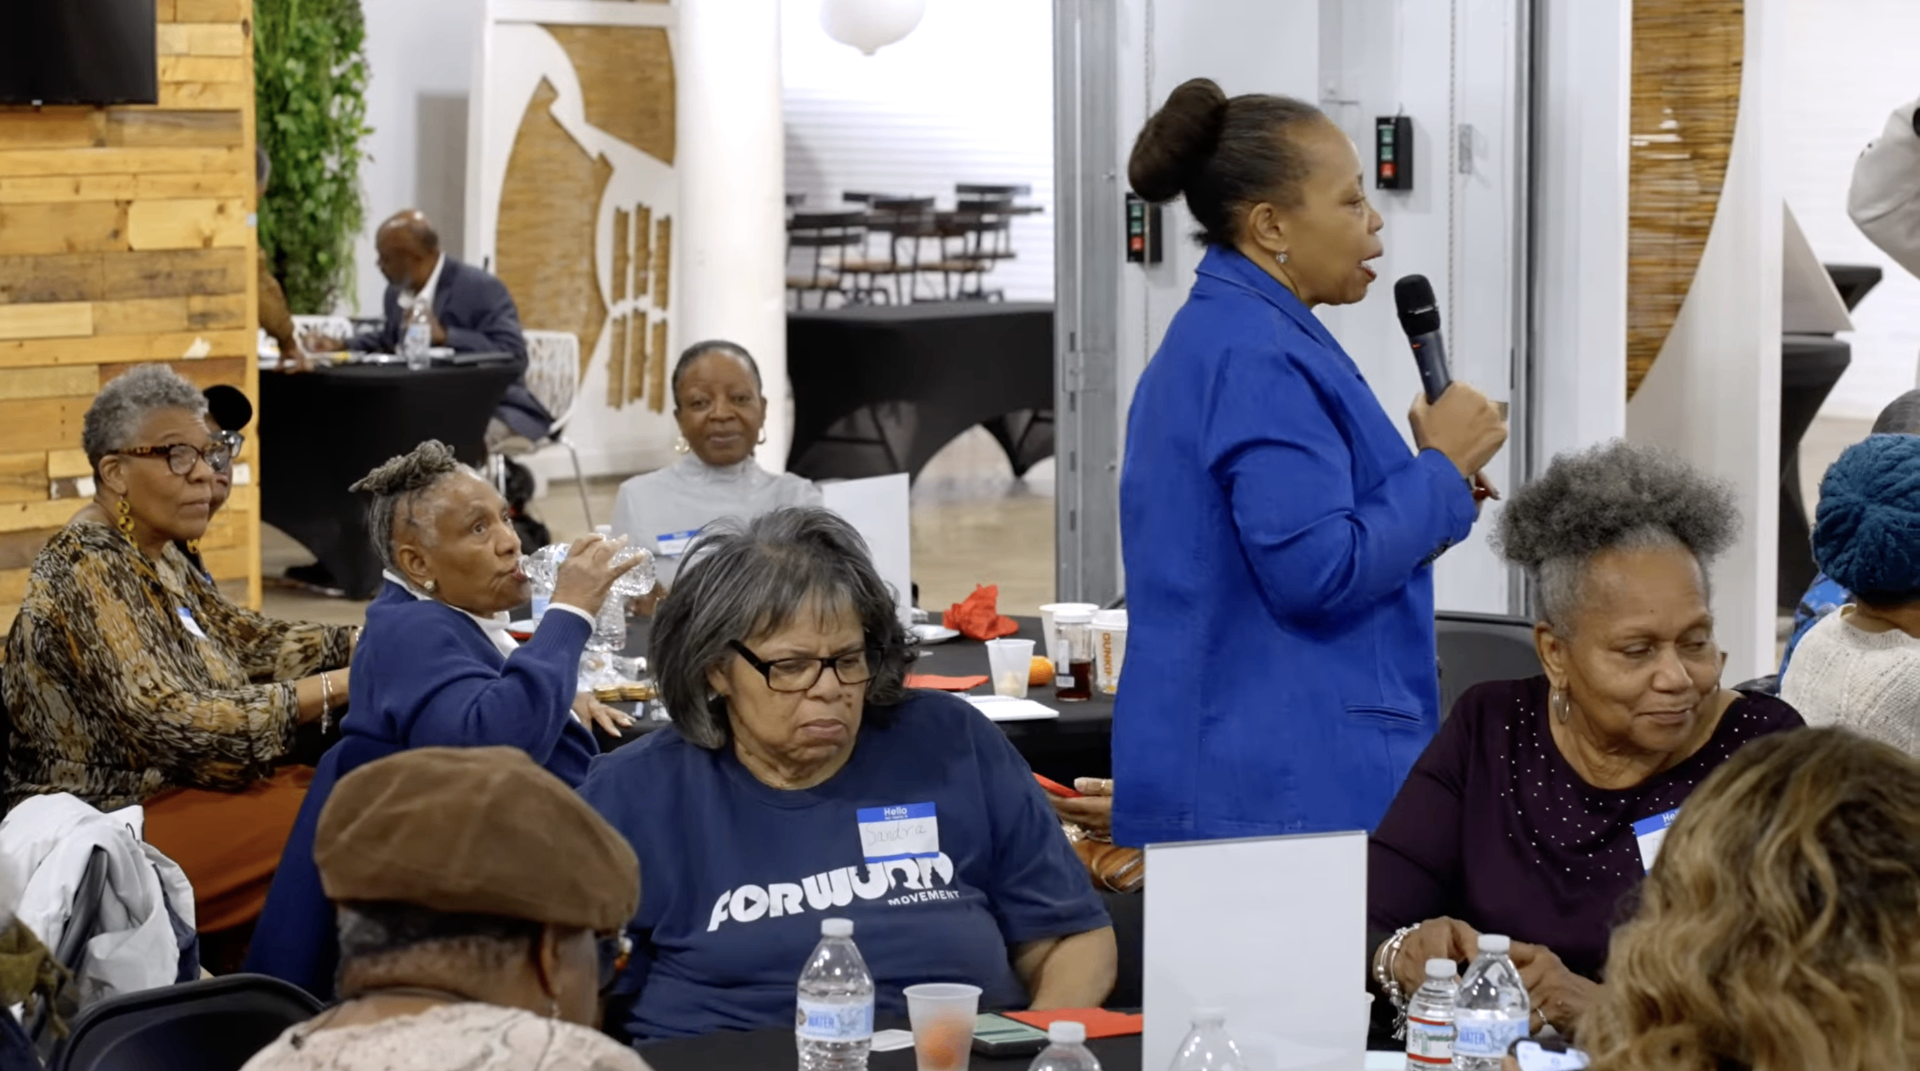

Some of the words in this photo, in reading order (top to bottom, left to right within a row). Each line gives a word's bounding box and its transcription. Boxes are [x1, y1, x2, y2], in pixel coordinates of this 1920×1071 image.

[884, 806, 908, 816] Hello
[866, 822, 926, 847] Sandra
[888, 890, 960, 906] MOVEMENT
[808, 1016, 834, 1028] WATER
[1459, 1029, 1486, 1045] WATER
